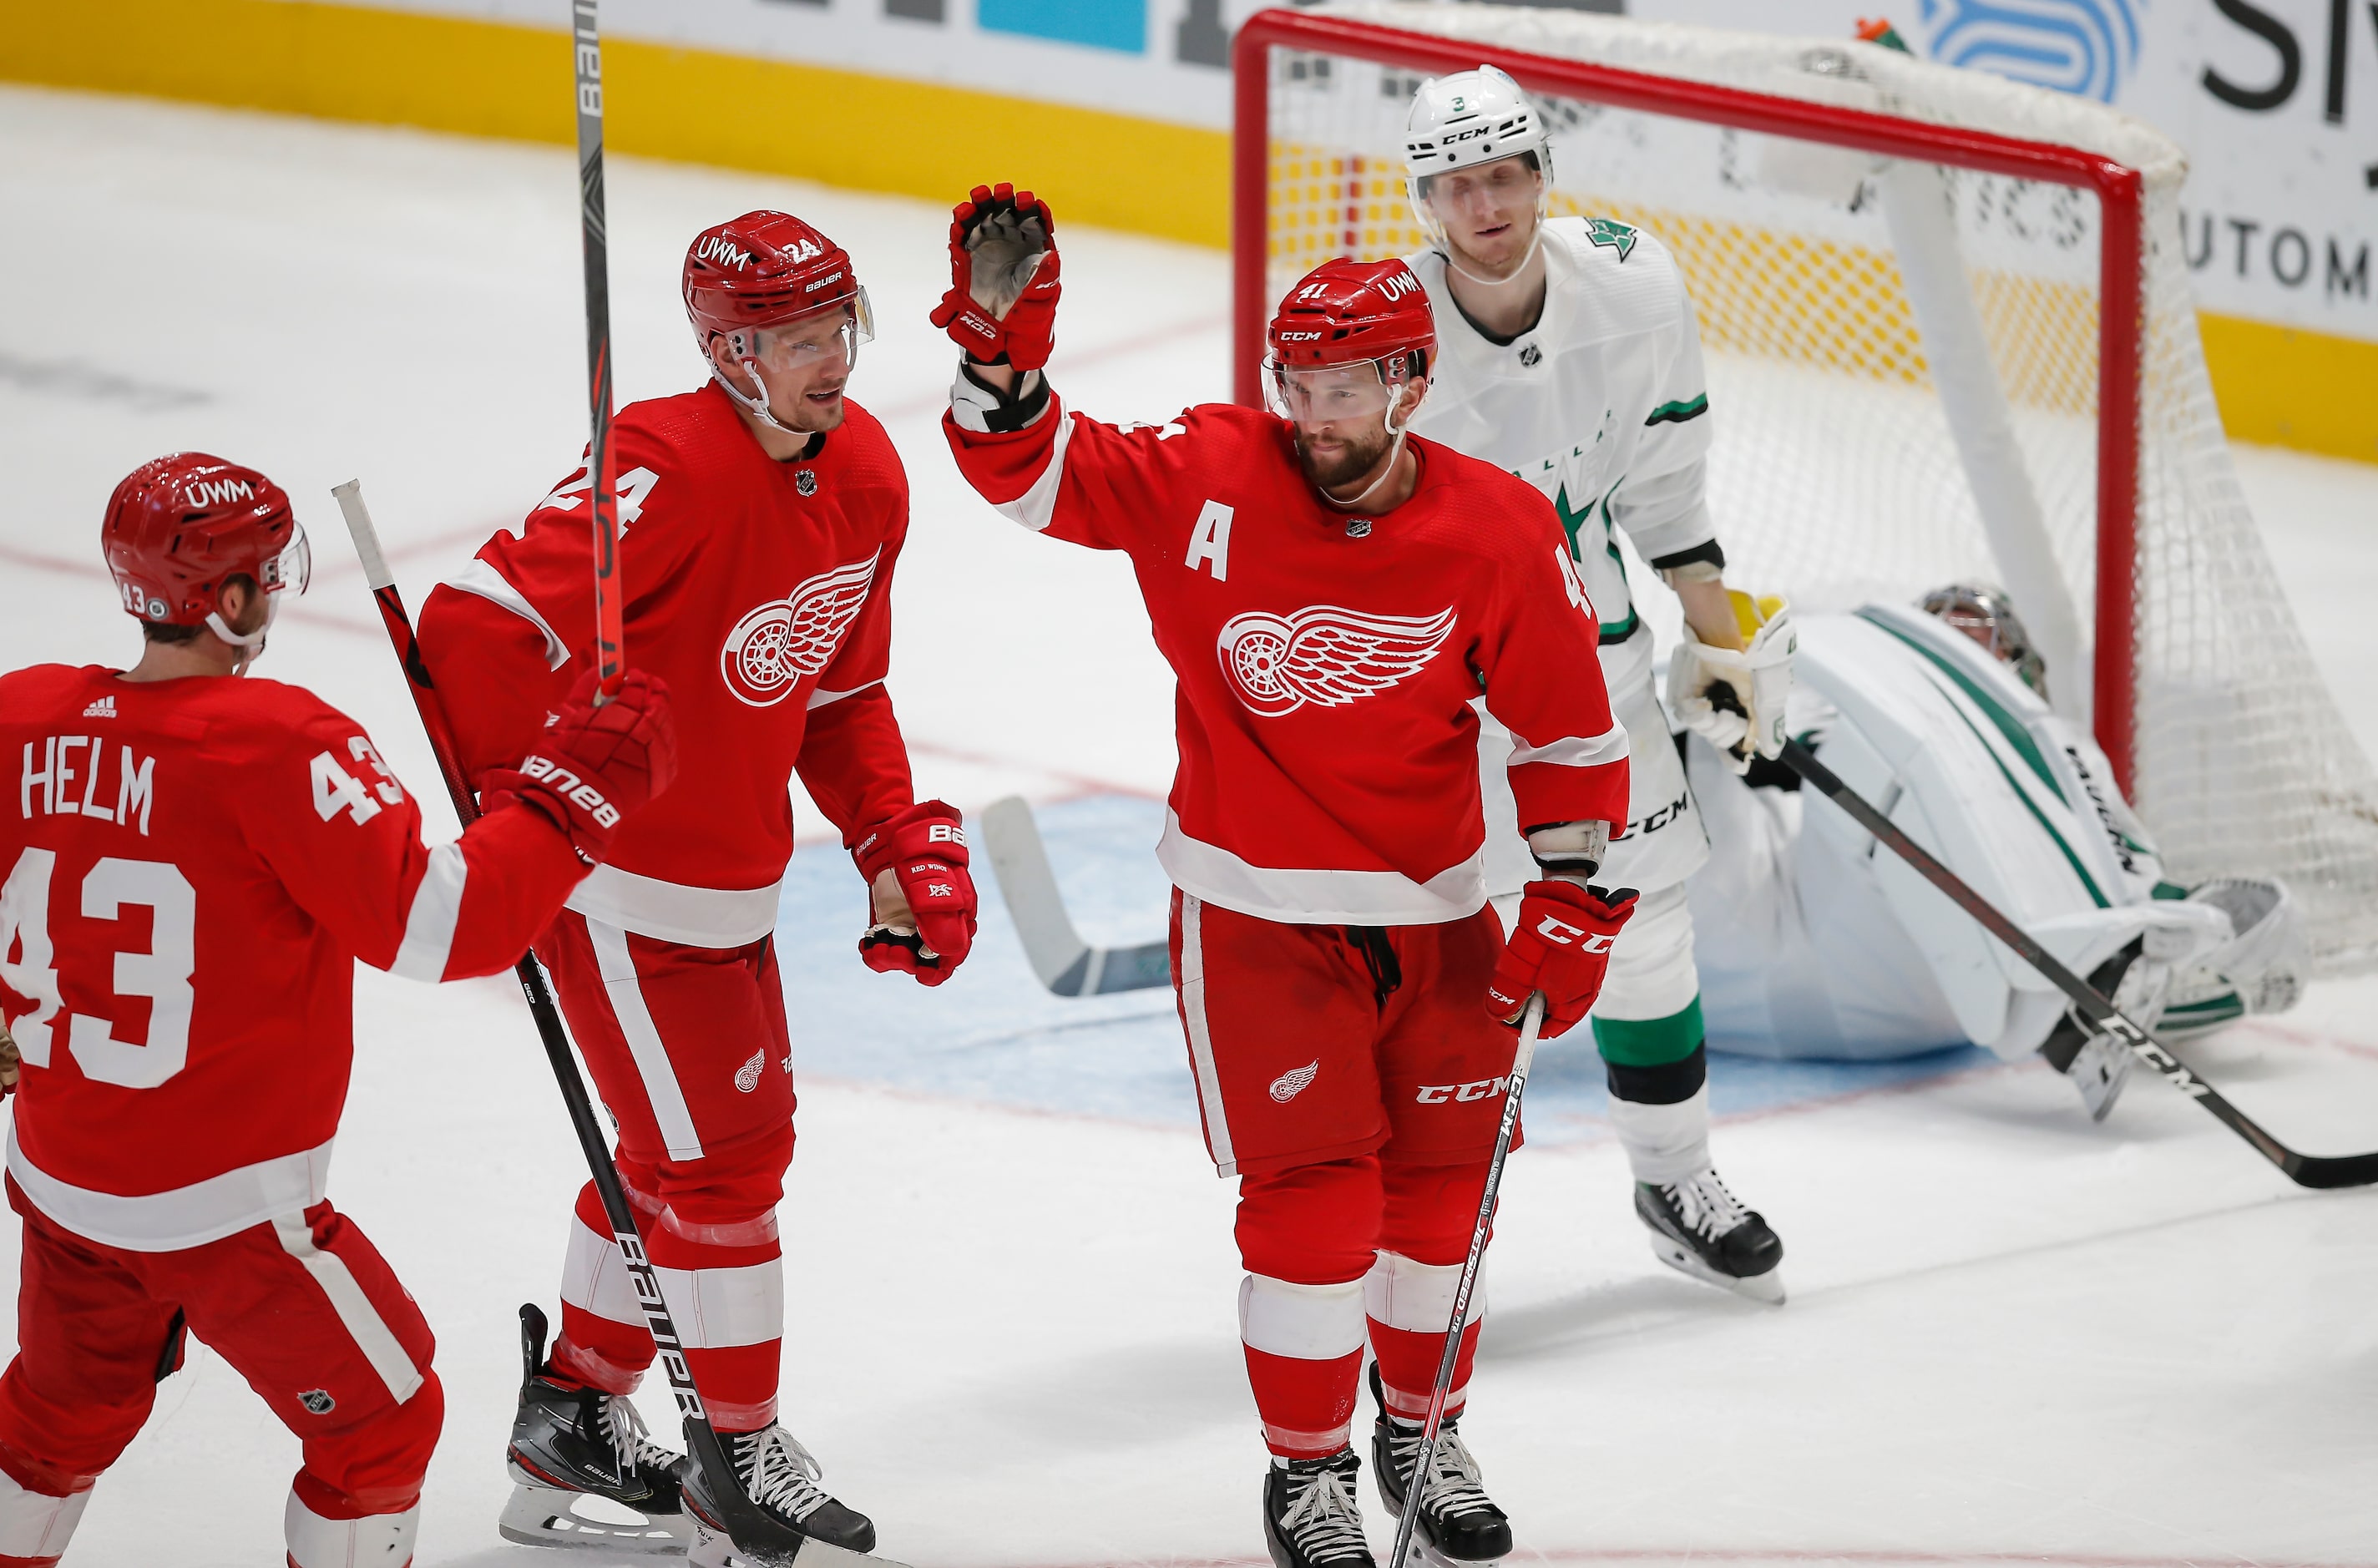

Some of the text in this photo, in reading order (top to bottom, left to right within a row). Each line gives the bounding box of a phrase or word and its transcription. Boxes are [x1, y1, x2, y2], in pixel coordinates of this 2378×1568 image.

[1451, 96, 1465, 112] 3
[1443, 126, 1490, 145] CCM
[696, 235, 751, 272] UWM
[782, 238, 824, 264] 24
[1297, 282, 1330, 305] 41
[1378, 269, 1421, 302] UWM
[959, 314, 997, 341] CCM
[1280, 331, 1323, 341] CCM
[185, 478, 255, 508] UWM
[1184, 498, 1235, 583] A
[121, 583, 145, 615] 43
[83, 707, 118, 719] adidas
[20, 736, 156, 837] HELM
[310, 735, 405, 827] 43
[911, 863, 948, 874] RED WINGS
[0, 846, 197, 1090] 43
[2098, 1013, 2211, 1099] CCM
[1416, 1074, 1512, 1104] CCM
[1500, 1075, 1525, 1137] CCM
[1486, 1161, 1500, 1196] GLENDENING
[1456, 1216, 1486, 1311] JETSPEED
[615, 1232, 706, 1420] BAUER
